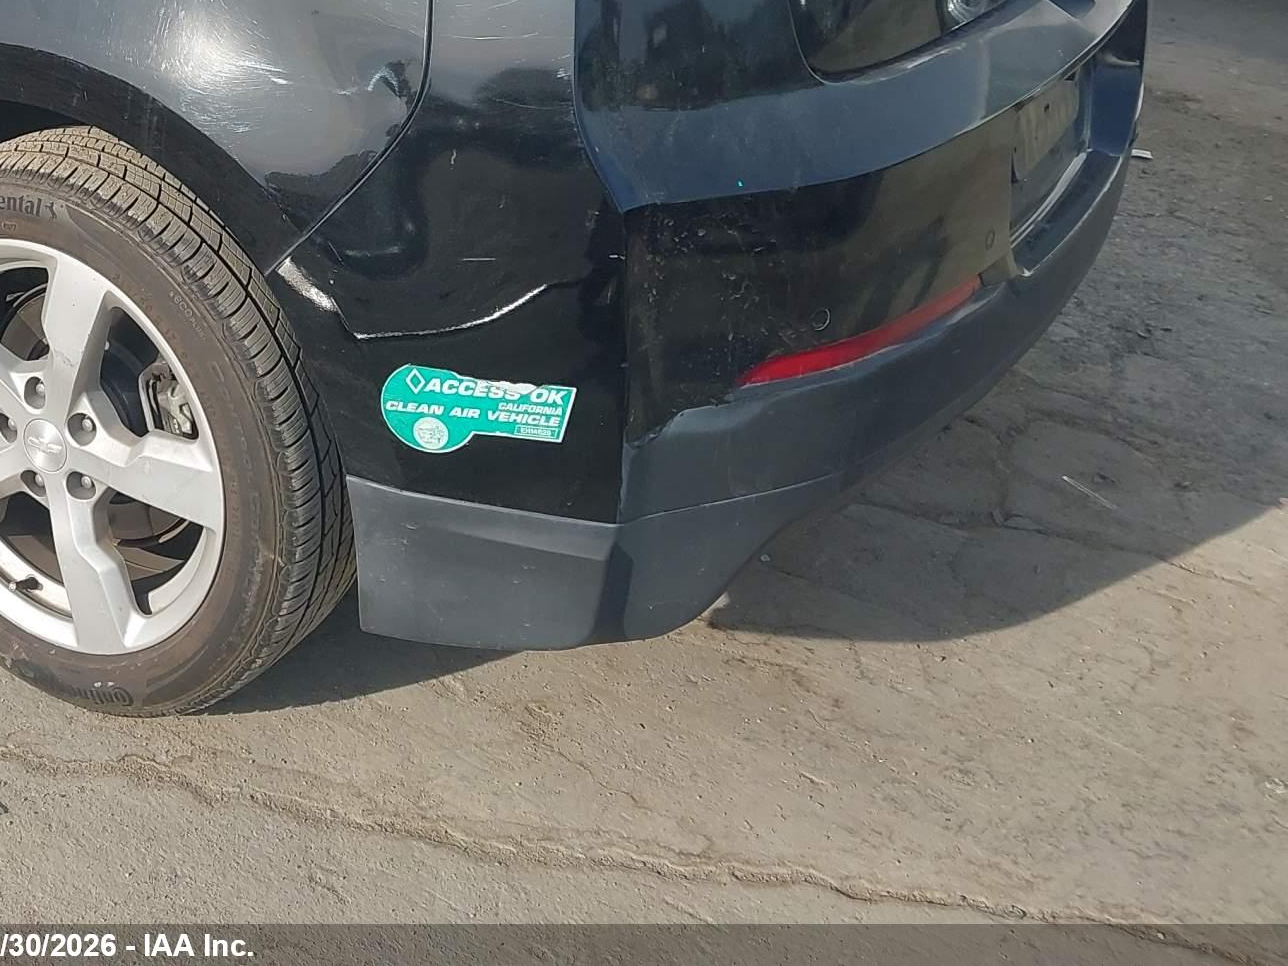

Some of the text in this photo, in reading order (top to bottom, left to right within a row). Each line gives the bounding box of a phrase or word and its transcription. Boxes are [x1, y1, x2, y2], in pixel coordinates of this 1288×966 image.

[529, 388, 569, 406] OK
[385, 400, 561, 427] CLEAN AIR VEHICLE
[498, 402, 563, 416] CALIFORNIA
